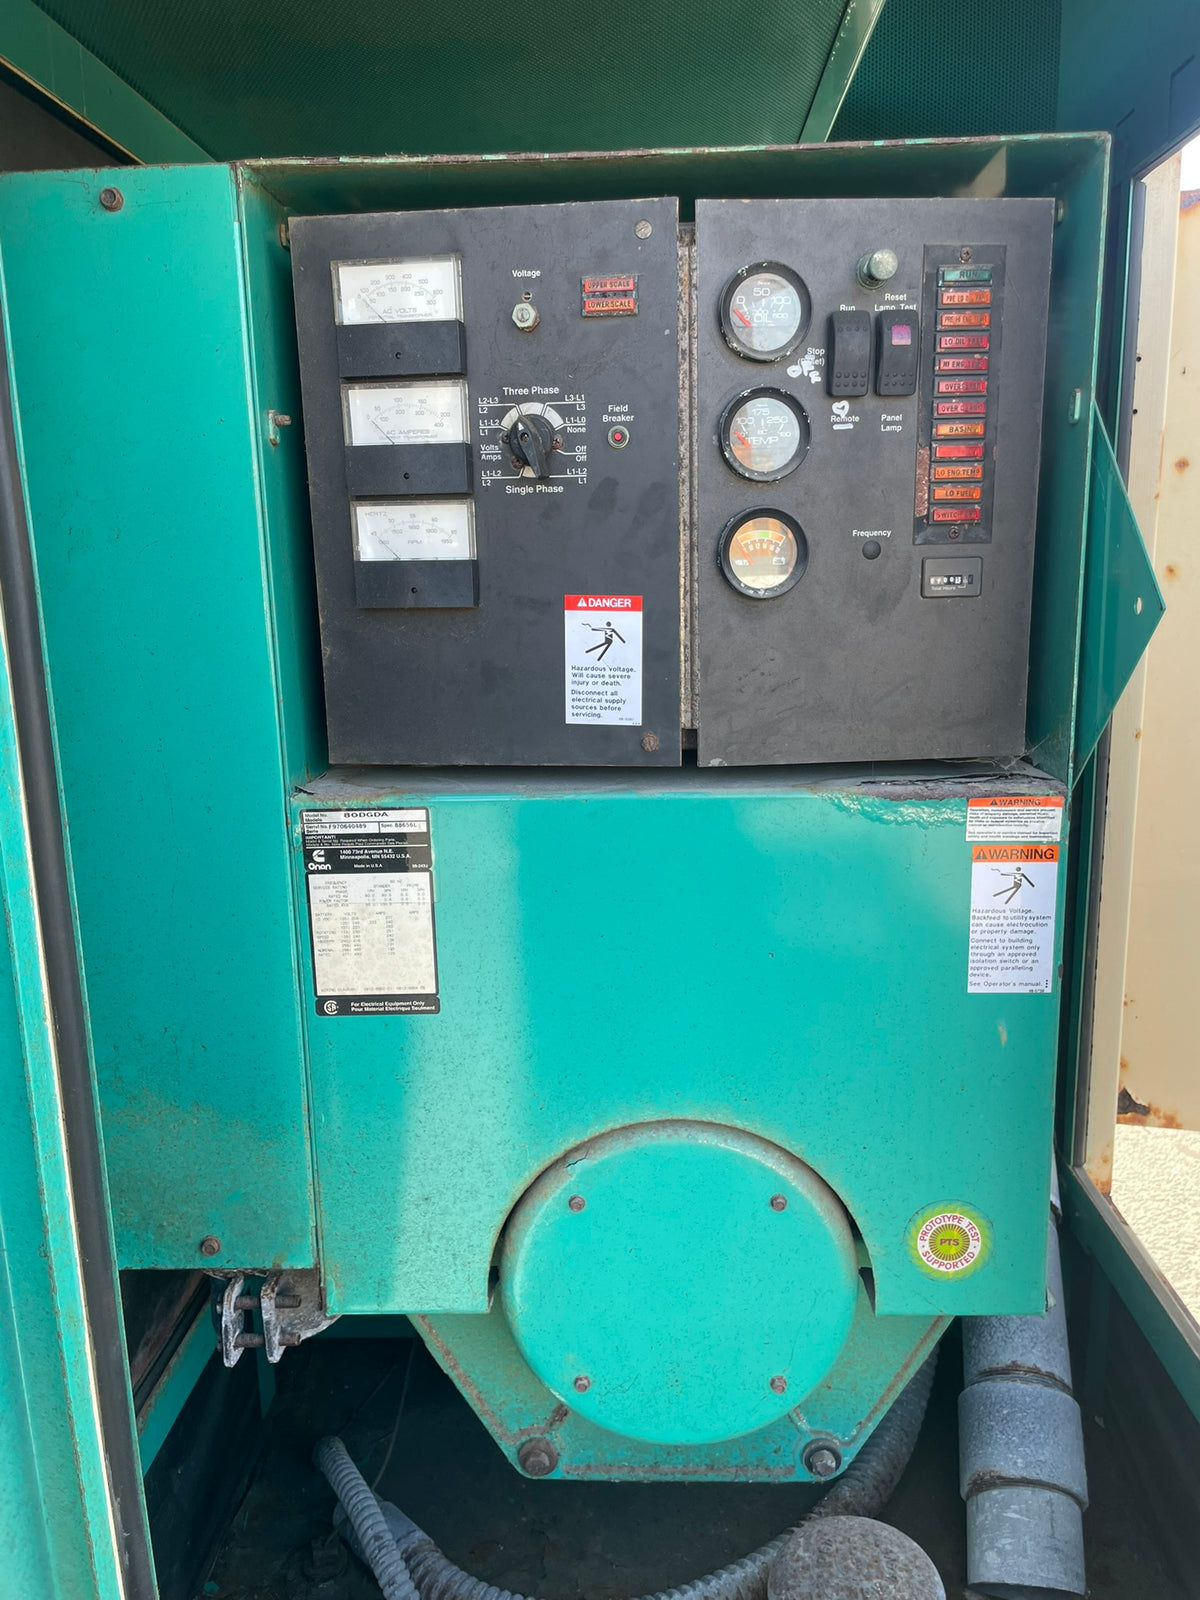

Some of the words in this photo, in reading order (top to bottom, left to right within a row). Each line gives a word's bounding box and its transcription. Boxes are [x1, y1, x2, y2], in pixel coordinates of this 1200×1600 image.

[512, 270, 541, 278] Voltage
[959, 270, 978, 278] RUN
[737, 296, 746, 304] 0
[753, 288, 770, 296] 50
[771, 296, 792, 304] 100
[807, 348, 825, 356] Stop
[503, 387, 529, 395] Three
[532, 386, 560, 394] Phase
[608, 404, 628, 412] Field
[602, 414, 634, 422] Breaker
[736, 416, 754, 425] 100
[752, 408, 770, 416] 175
[766, 416, 788, 424] 250
[746, 436, 778, 444] TEMP
[505, 485, 534, 495] Single
[536, 484, 564, 493] Phase
[852, 530, 892, 538] Frequency
[588, 598, 632, 608] DANGER
[988, 848, 1054, 860] WARNING
[919, 1214, 965, 1242] PROTOTYPE
[964, 1222, 980, 1243] TEST
[940, 1238, 960, 1246] PTS
[922, 1250, 976, 1270] SUPPORTED
